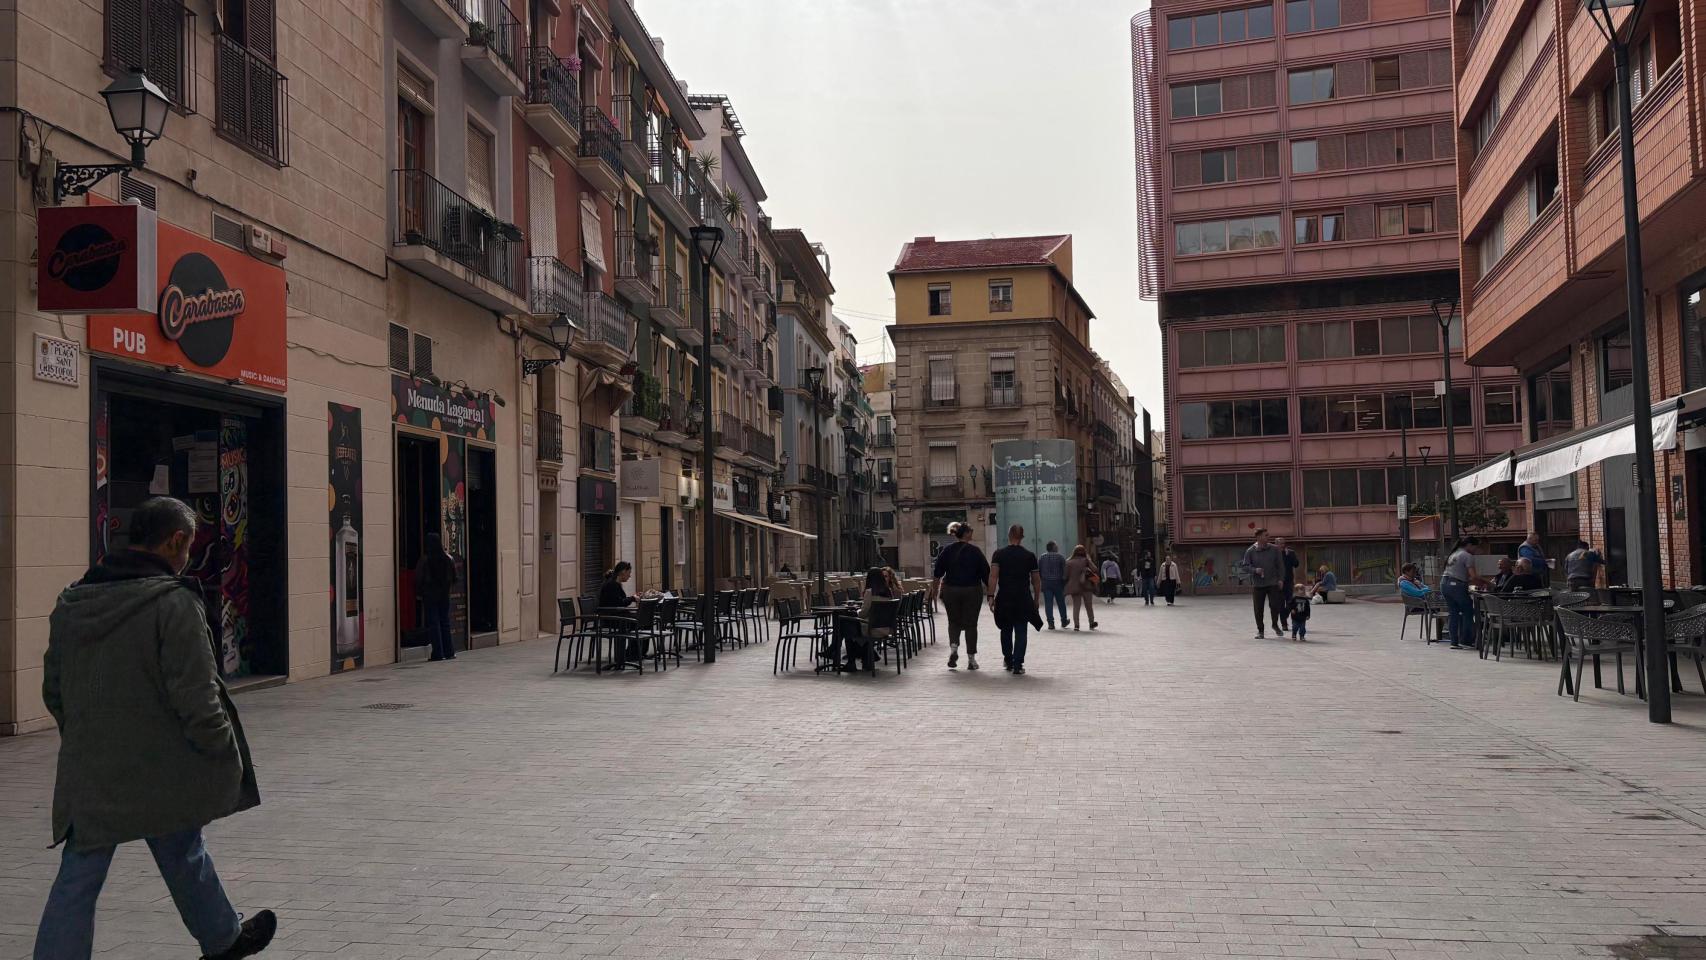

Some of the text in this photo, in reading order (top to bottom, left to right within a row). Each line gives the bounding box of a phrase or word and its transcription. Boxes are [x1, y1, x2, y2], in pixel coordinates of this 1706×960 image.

[161, 285, 245, 340] Carabassa
[113, 327, 146, 354] PUB
[56, 357, 72, 367] SANT
[240, 369, 258, 380] MUSIC
[262, 374, 286, 387] DANCING
[407, 388, 445, 414] Menuda
[446, 399, 485, 428] Lagarta!
